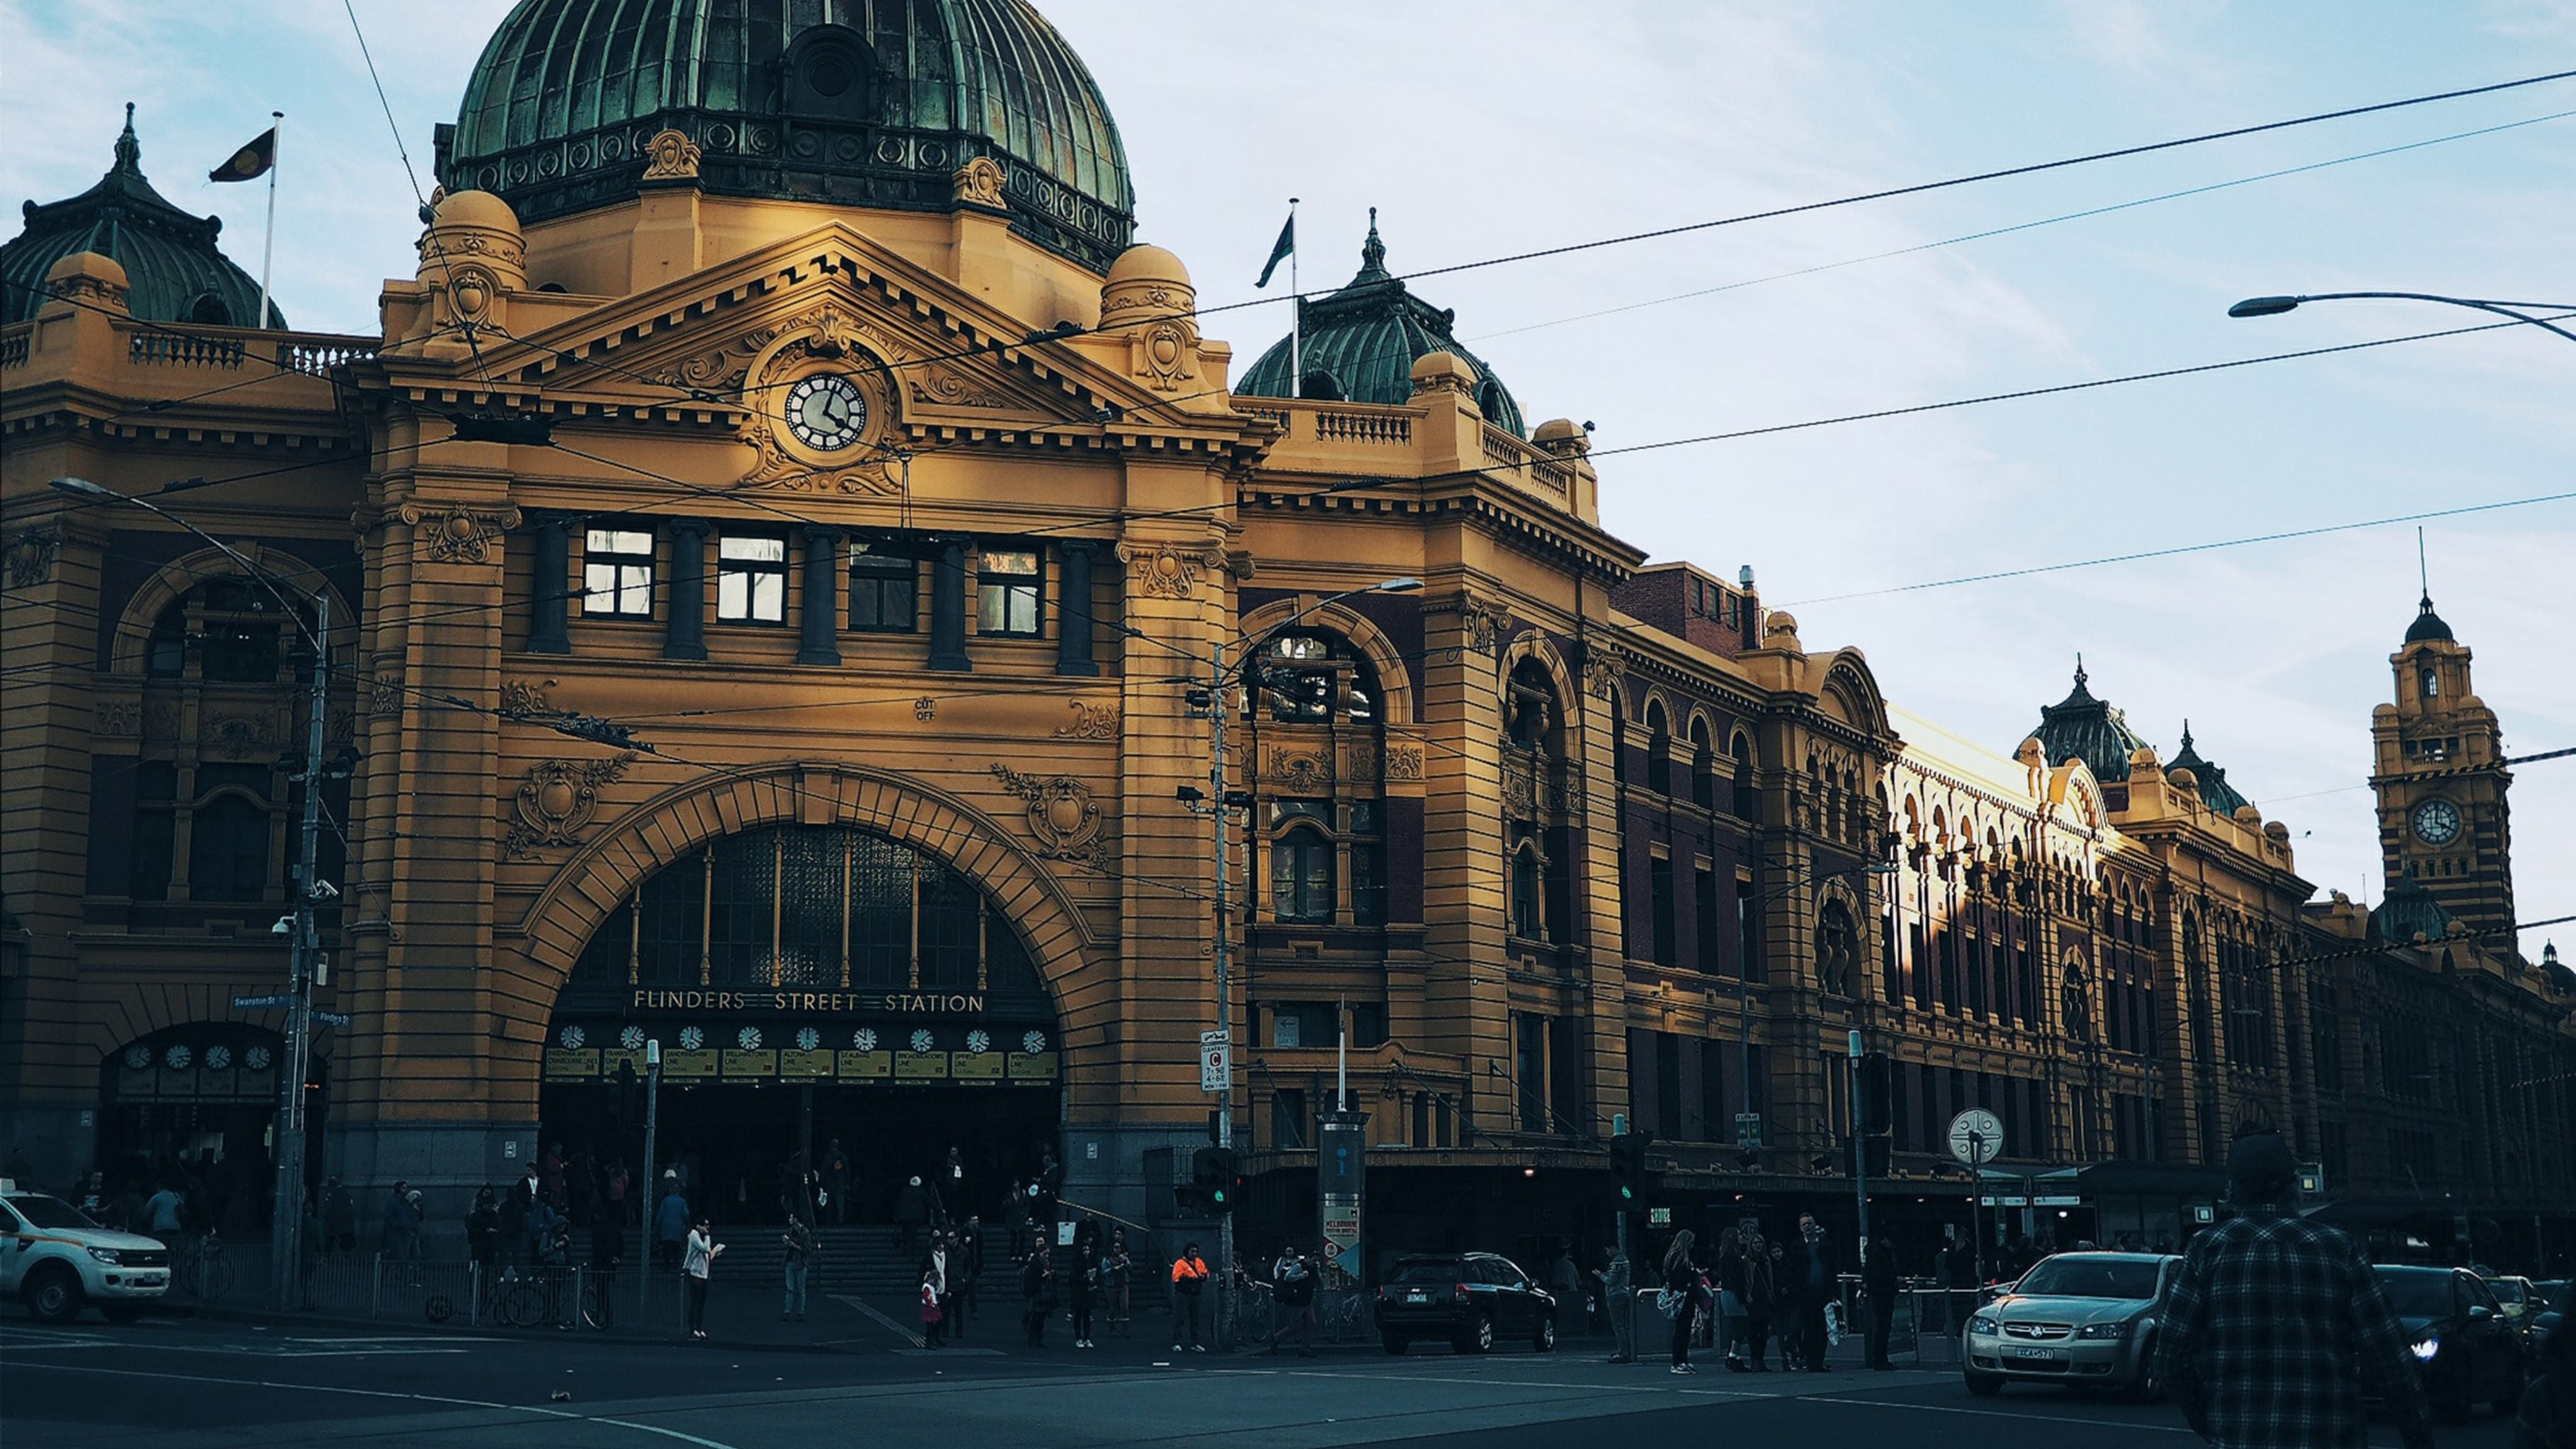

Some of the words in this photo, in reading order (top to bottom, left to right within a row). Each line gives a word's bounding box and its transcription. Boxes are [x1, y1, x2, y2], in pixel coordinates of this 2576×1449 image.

[234, 997, 267, 1006] Swanston
[267, 996, 275, 1004] St
[634, 990, 745, 1009] FLINDERS
[774, 992, 858, 1011] STREET
[885, 994, 983, 1012] STATION
